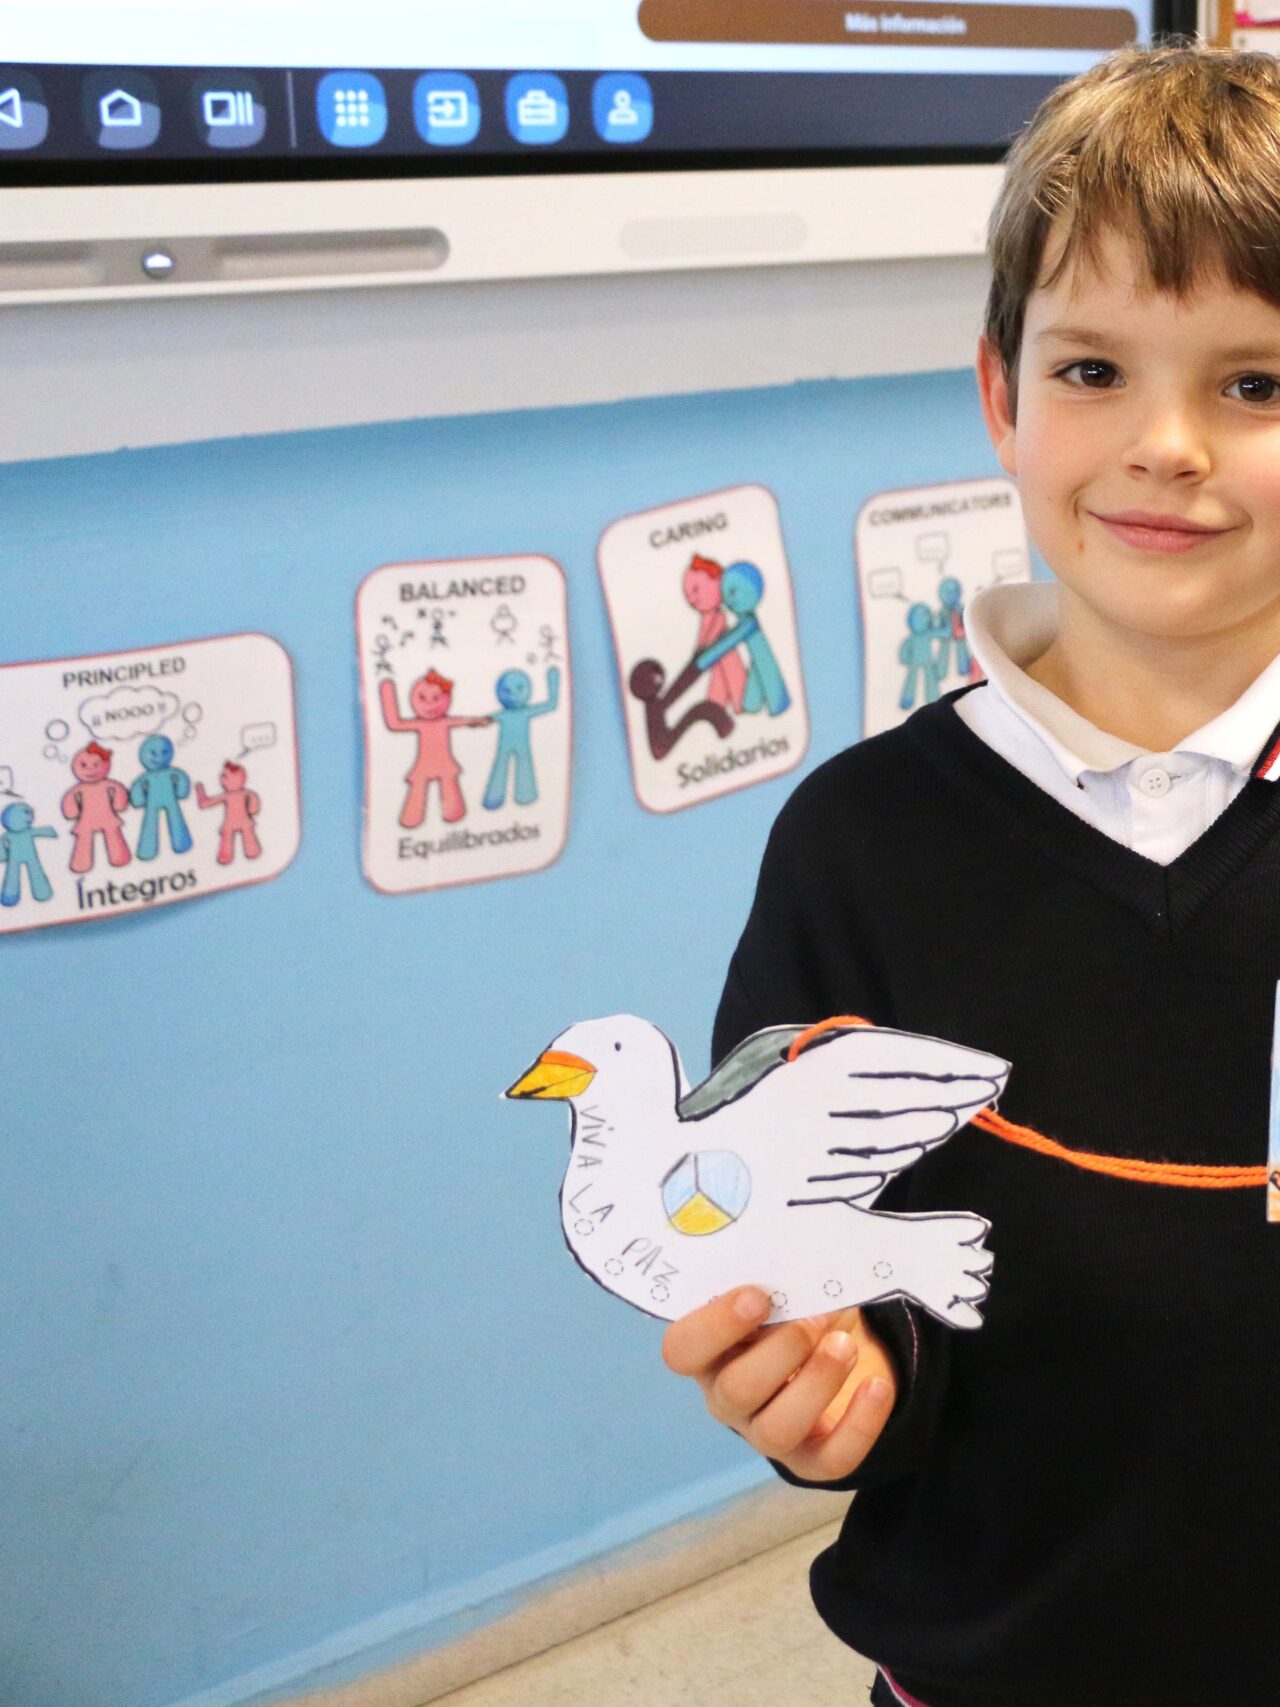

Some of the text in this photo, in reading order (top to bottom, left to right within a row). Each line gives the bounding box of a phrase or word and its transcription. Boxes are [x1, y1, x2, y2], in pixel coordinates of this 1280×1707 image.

[649, 512, 728, 549] CARING
[400, 575, 526, 601] BALANCED
[63, 656, 186, 688] PRINCIPLED
[677, 735, 789, 787] Solidarios
[398, 822, 541, 860] Equilibrados
[77, 869, 198, 911] Íntegros
[621, 1238, 679, 1286] PAZ
